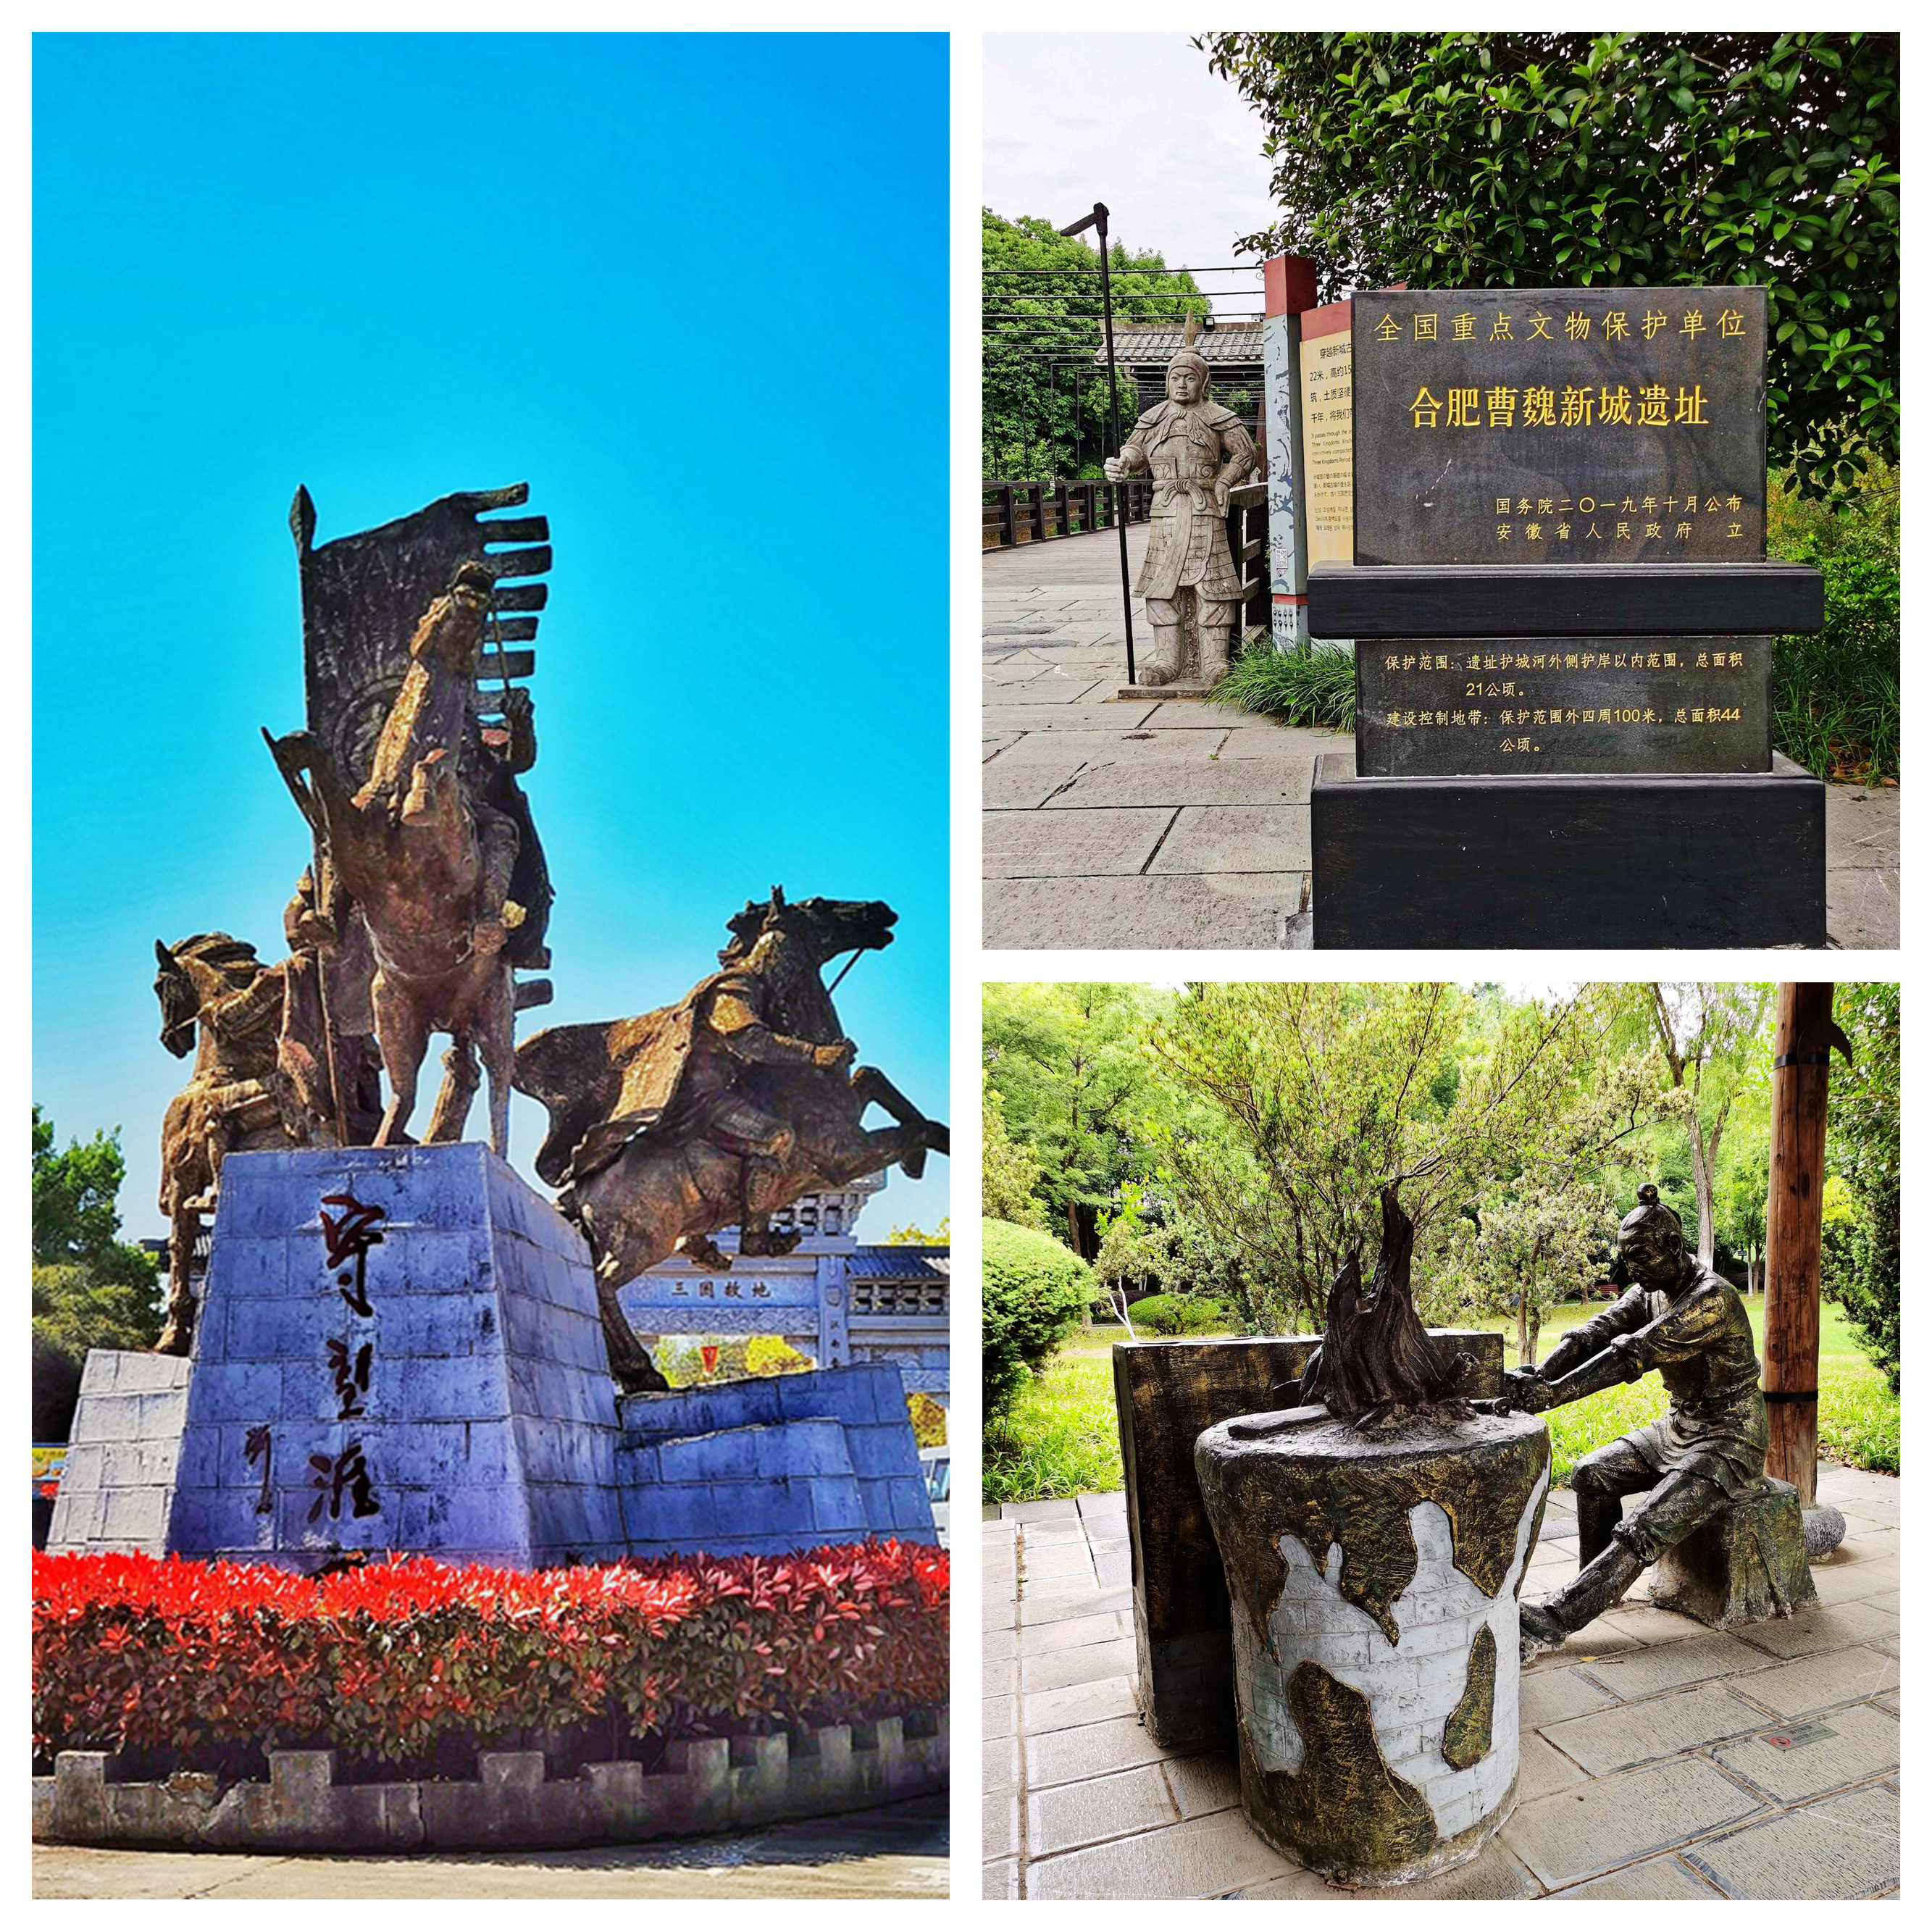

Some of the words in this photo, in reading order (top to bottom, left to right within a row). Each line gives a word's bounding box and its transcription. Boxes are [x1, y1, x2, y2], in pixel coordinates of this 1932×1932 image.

[1373, 310, 1747, 342] 全国重点文物保护单位
[1409, 384, 1710, 428] 合肥曹魏新城遗址
[1496, 522, 1693, 540] 安徽省人民政府
[1726, 523, 1744, 538] 立
[1466, 682, 1526, 698] 21公顷。
[1500, 737, 1543, 753] 公顷。
